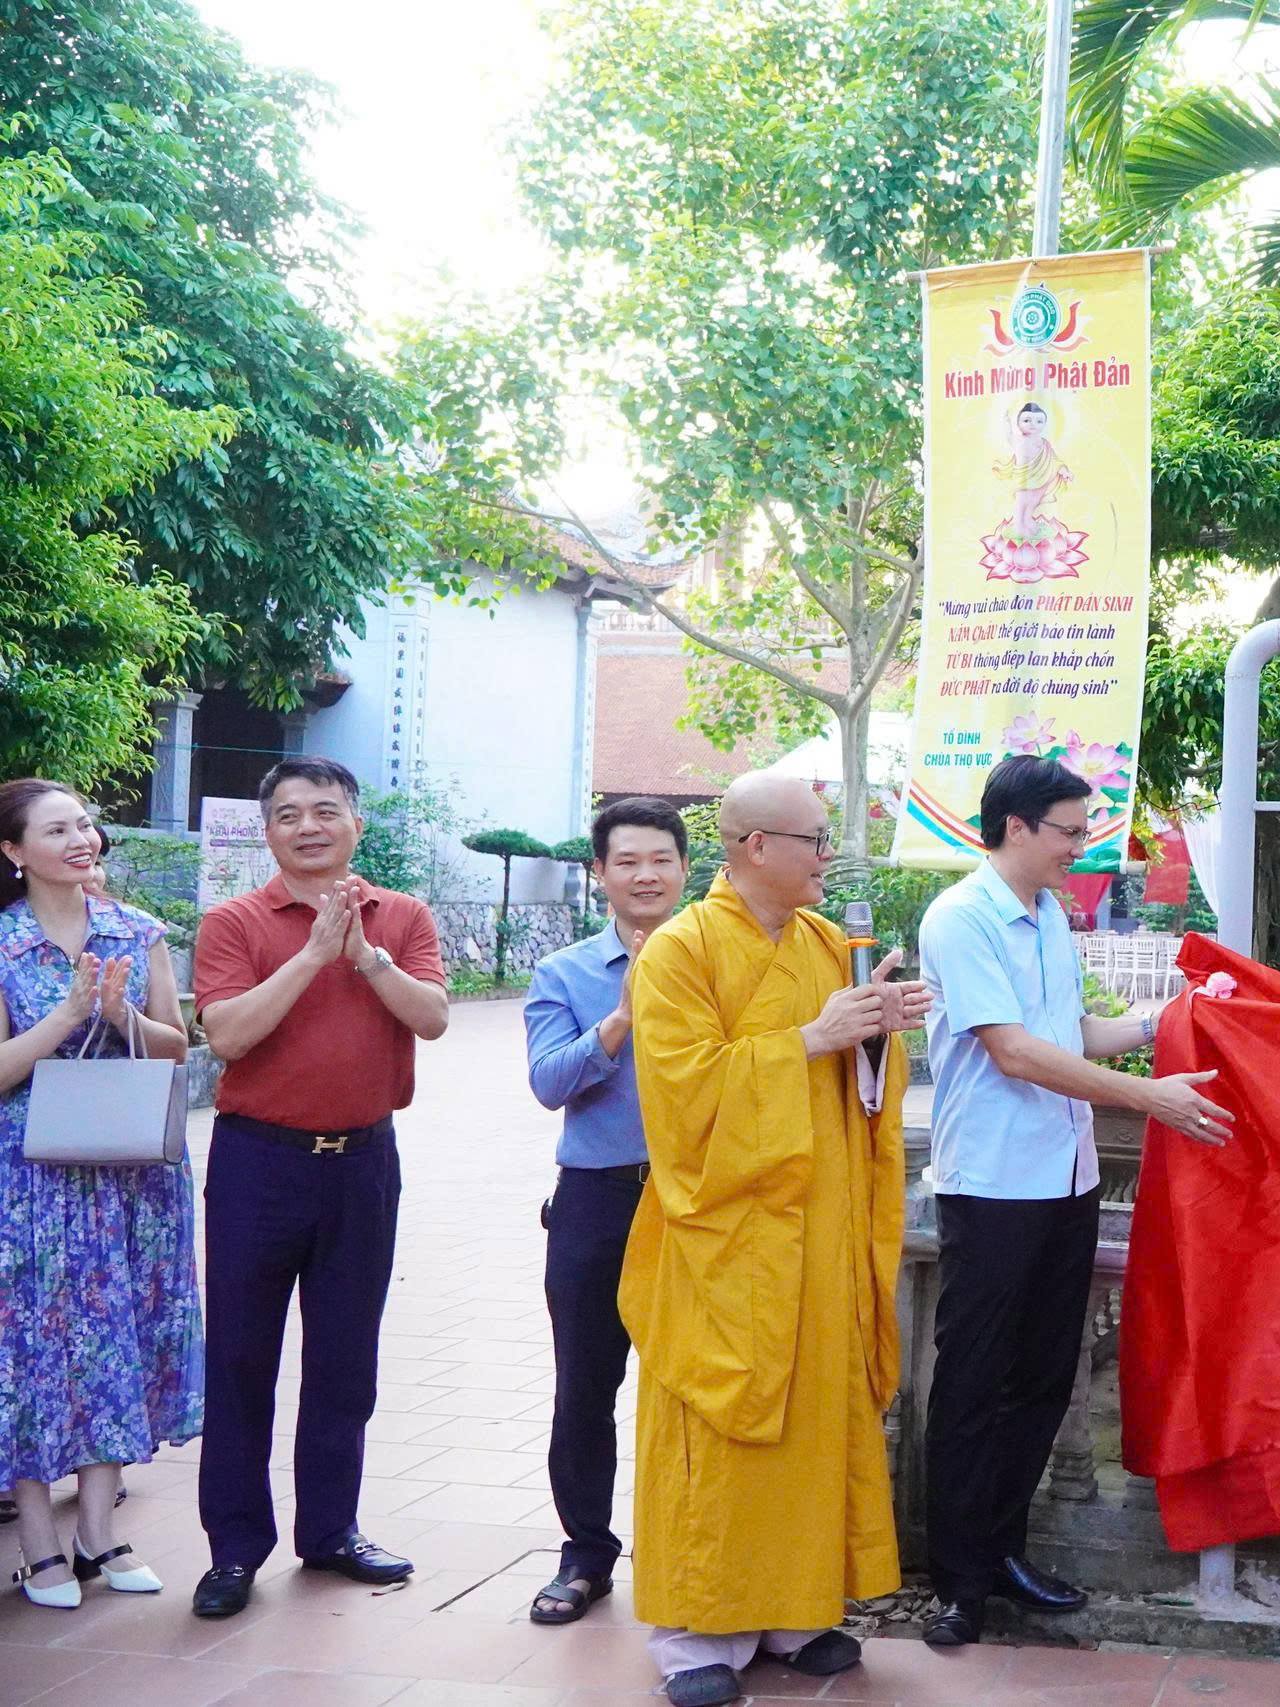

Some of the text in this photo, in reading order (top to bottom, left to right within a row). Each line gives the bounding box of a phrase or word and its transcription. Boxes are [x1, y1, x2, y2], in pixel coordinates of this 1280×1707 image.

[945, 356, 1130, 398] Kính Mừng Phật Đản
[973, 598, 988, 613] vui
[988, 595, 1009, 612] chào
[1010, 594, 1033, 610] đón
[1036, 592, 1072, 615] PHẬT
[1103, 595, 1134, 612] SINH
[998, 619, 1014, 638] thế
[1013, 622, 1039, 641] giới
[1041, 622, 1064, 639] báo
[1066, 624, 1084, 639] tin
[1087, 623, 1115, 639] lành
[961, 653, 973, 668] BI
[1001, 649, 1025, 669] điệp
[1027, 651, 1049, 666] lan
[1051, 649, 1083, 670] khắp
[1085, 650, 1115, 667] chốn
[991, 682, 1001, 694] ra
[1002, 676, 1021, 693] đời
[1023, 678, 1039, 698] độ
[1041, 678, 1080, 699] chúng
[943, 728, 955, 745] TỔ
[924, 752, 993, 769] CHÙA THỌ VỰC
